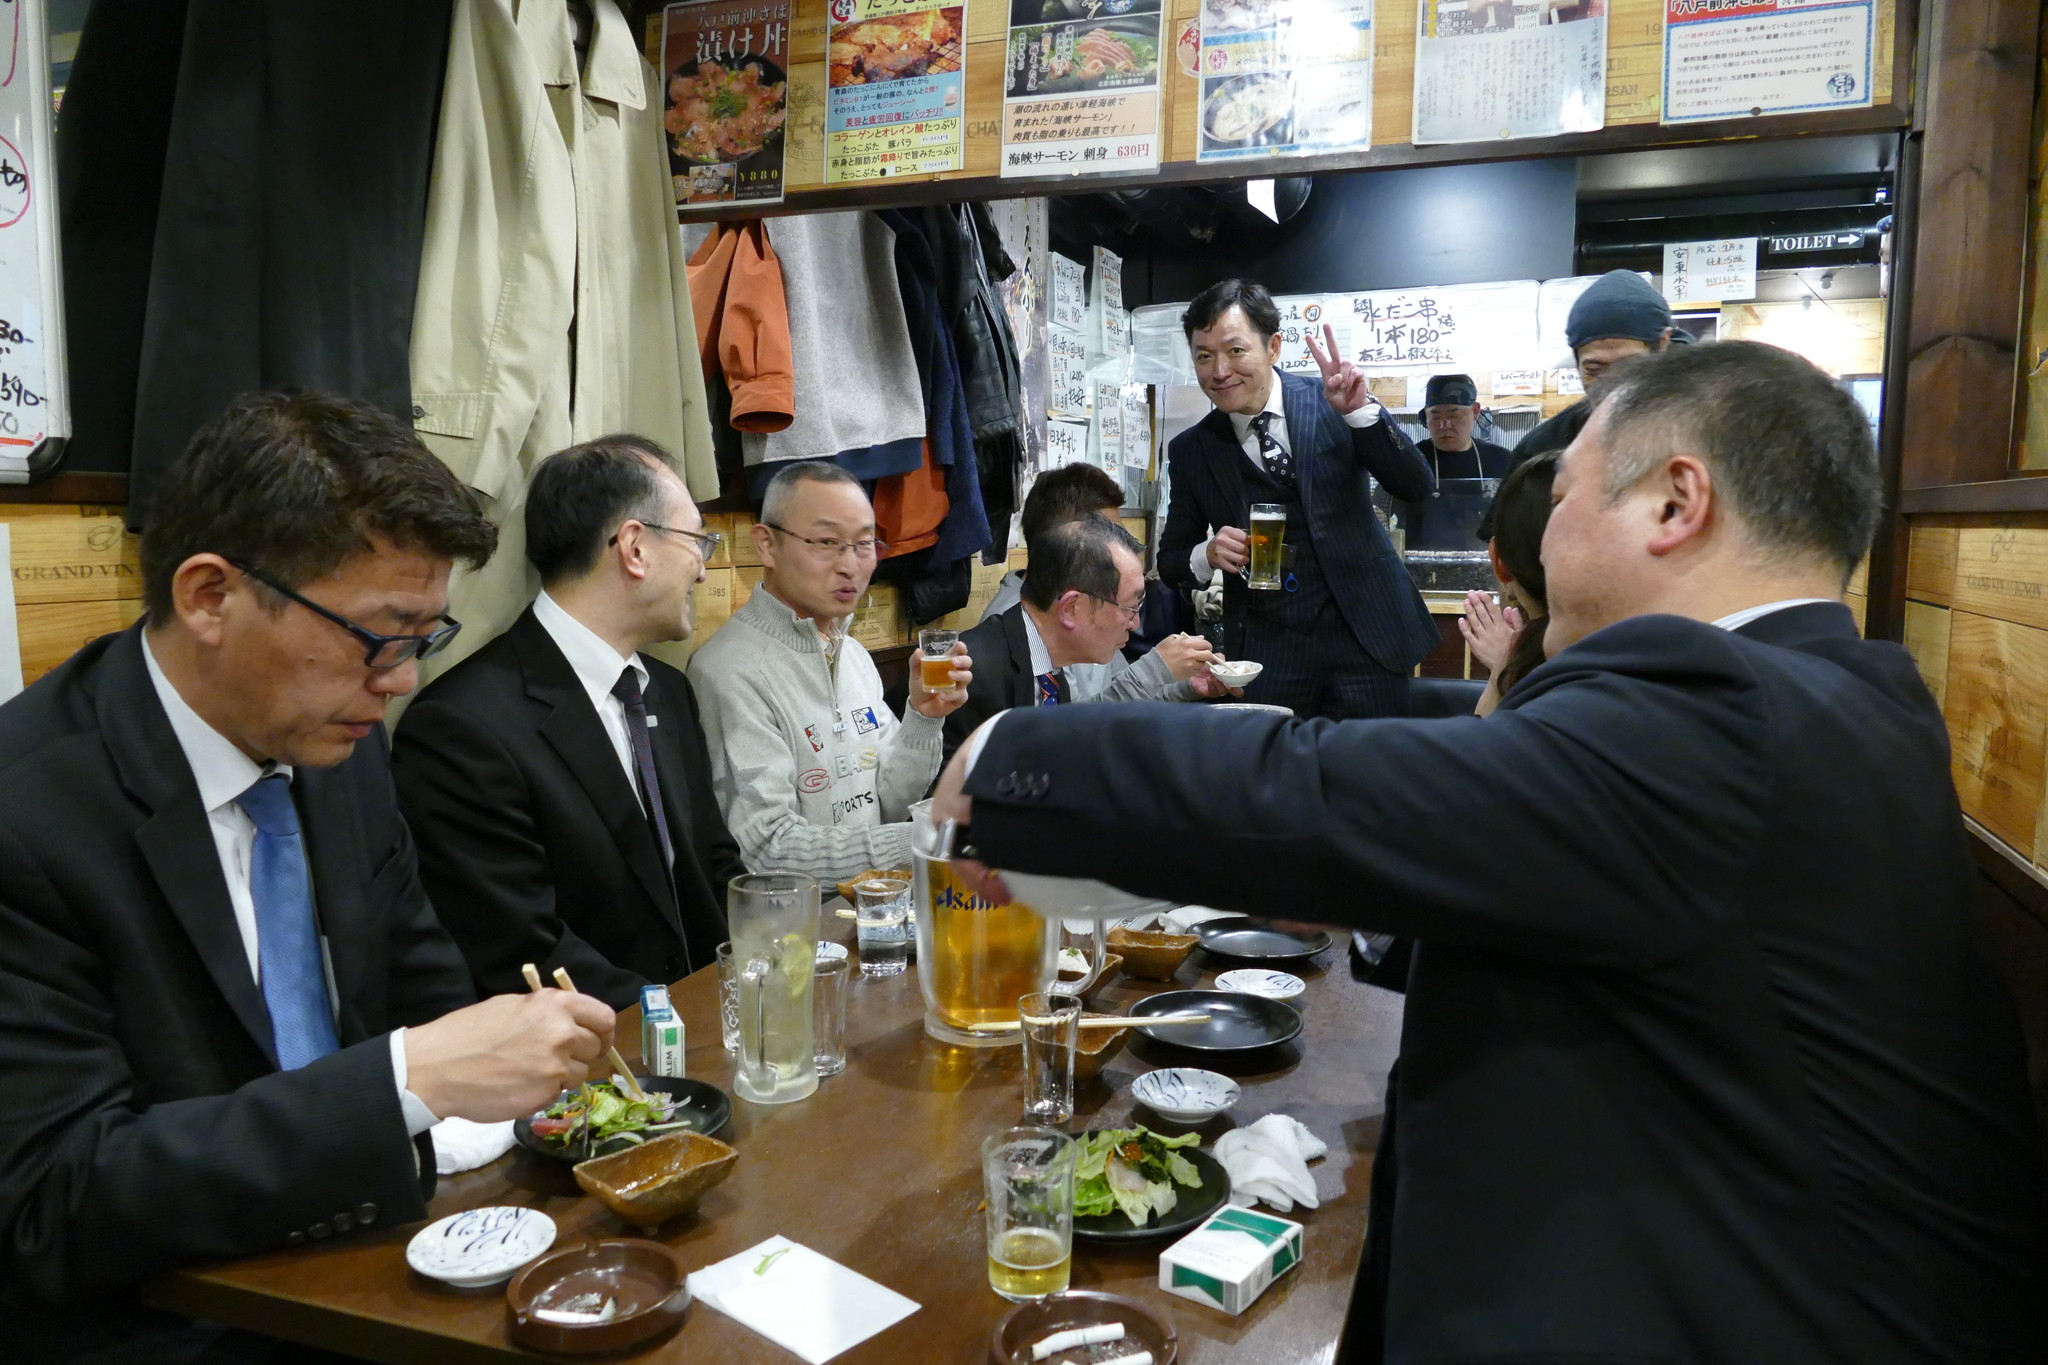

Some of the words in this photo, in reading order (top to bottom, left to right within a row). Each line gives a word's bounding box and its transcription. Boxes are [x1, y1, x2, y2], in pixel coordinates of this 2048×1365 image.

[698, 4, 788, 28] 八戸前沖さば
[696, 22, 787, 64] 漬け丼
[1013, 97, 1127, 115] 潮の流れの速い津軽海峡で
[966, 119, 1001, 138] CHA
[1013, 113, 1113, 128] 育まれた「海峡サーモン」
[833, 119, 957, 142] コラーゲンとオレイン酸たっぷり
[843, 142, 880, 154] たっこぶた
[888, 139, 913, 149] 豚バラ
[1008, 151, 1080, 166] 海峡サーモン
[1083, 147, 1109, 161] 刺身
[1117, 143, 1150, 158] 630円
[831, 146, 958, 168] 赤身と脂肪が霜降りで旨みたっぷり
[840, 168, 878, 180] たっこぶた
[895, 164, 918, 173] ロース
[1771, 234, 1836, 251] TOILET
[14, 565, 94, 582] GRAND
[100, 563, 137, 577] VIN
[708, 587, 726, 598] 1985
